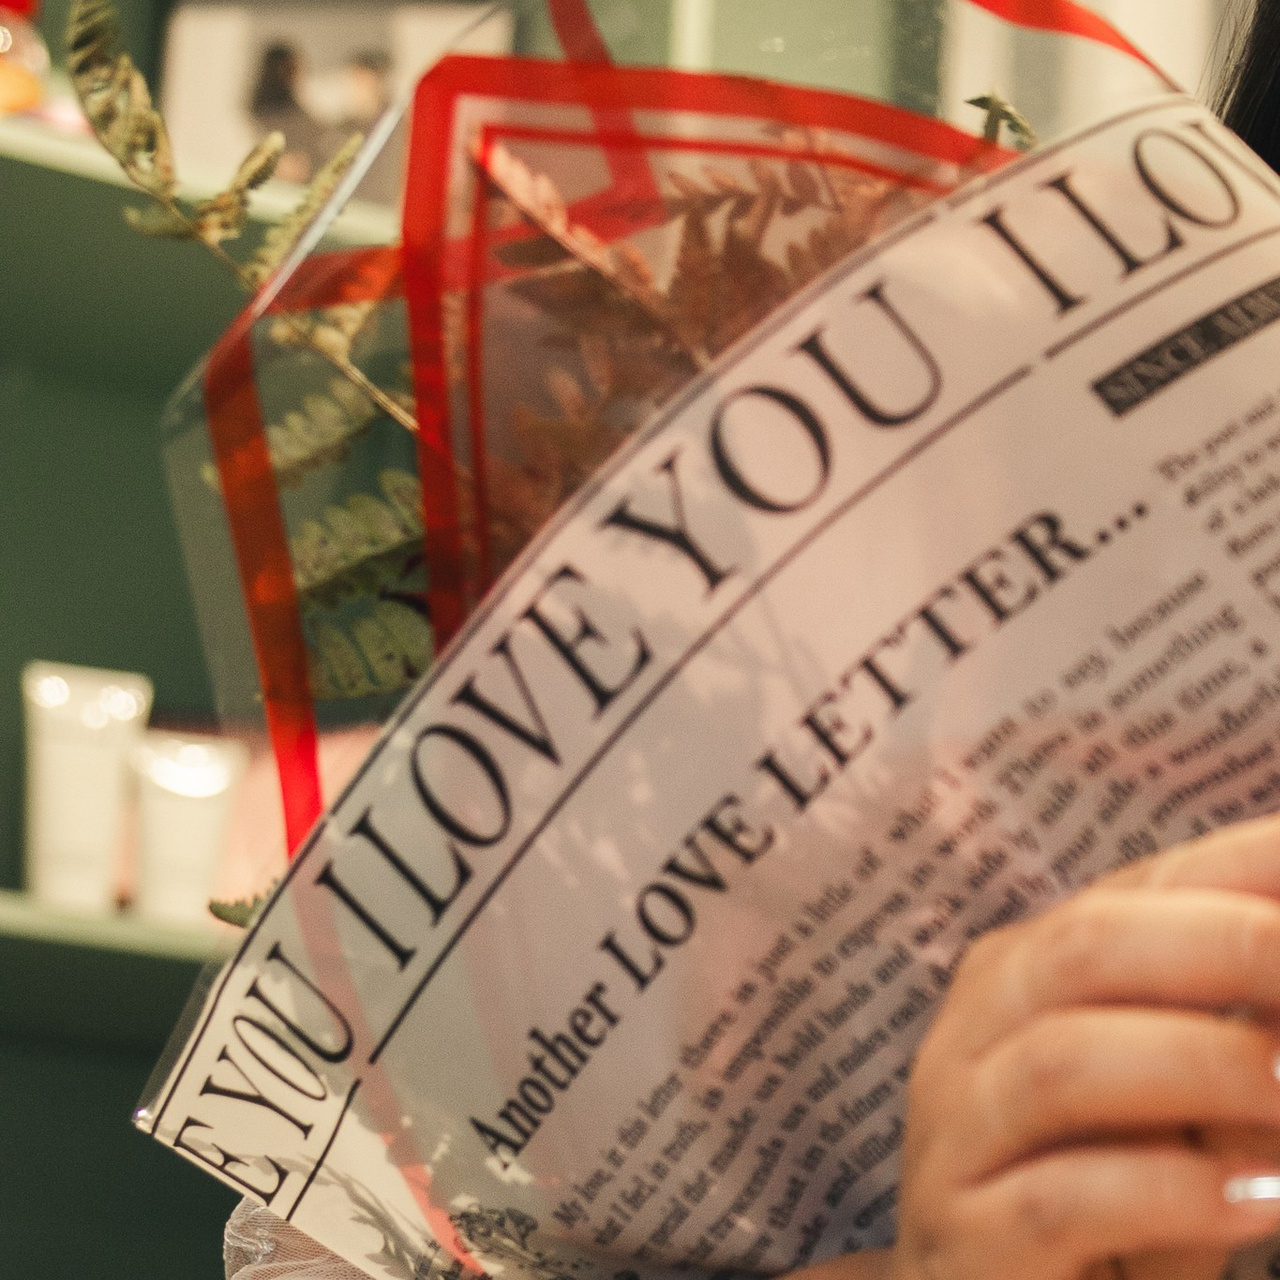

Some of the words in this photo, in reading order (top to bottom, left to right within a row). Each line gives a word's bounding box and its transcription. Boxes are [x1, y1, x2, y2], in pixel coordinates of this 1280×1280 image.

[977, 205, 1089, 320] I
[600, 276, 943, 601] YOU
[348, 564, 654, 927] LOVE
[469, 982, 621, 1166] Another
[599, 795, 774, 992] LOVE
[754, 502, 1149, 814] LETTER...
[315, 860, 416, 973] I
[199, 941, 355, 1141] YOU
[173, 1116, 290, 1206] E
